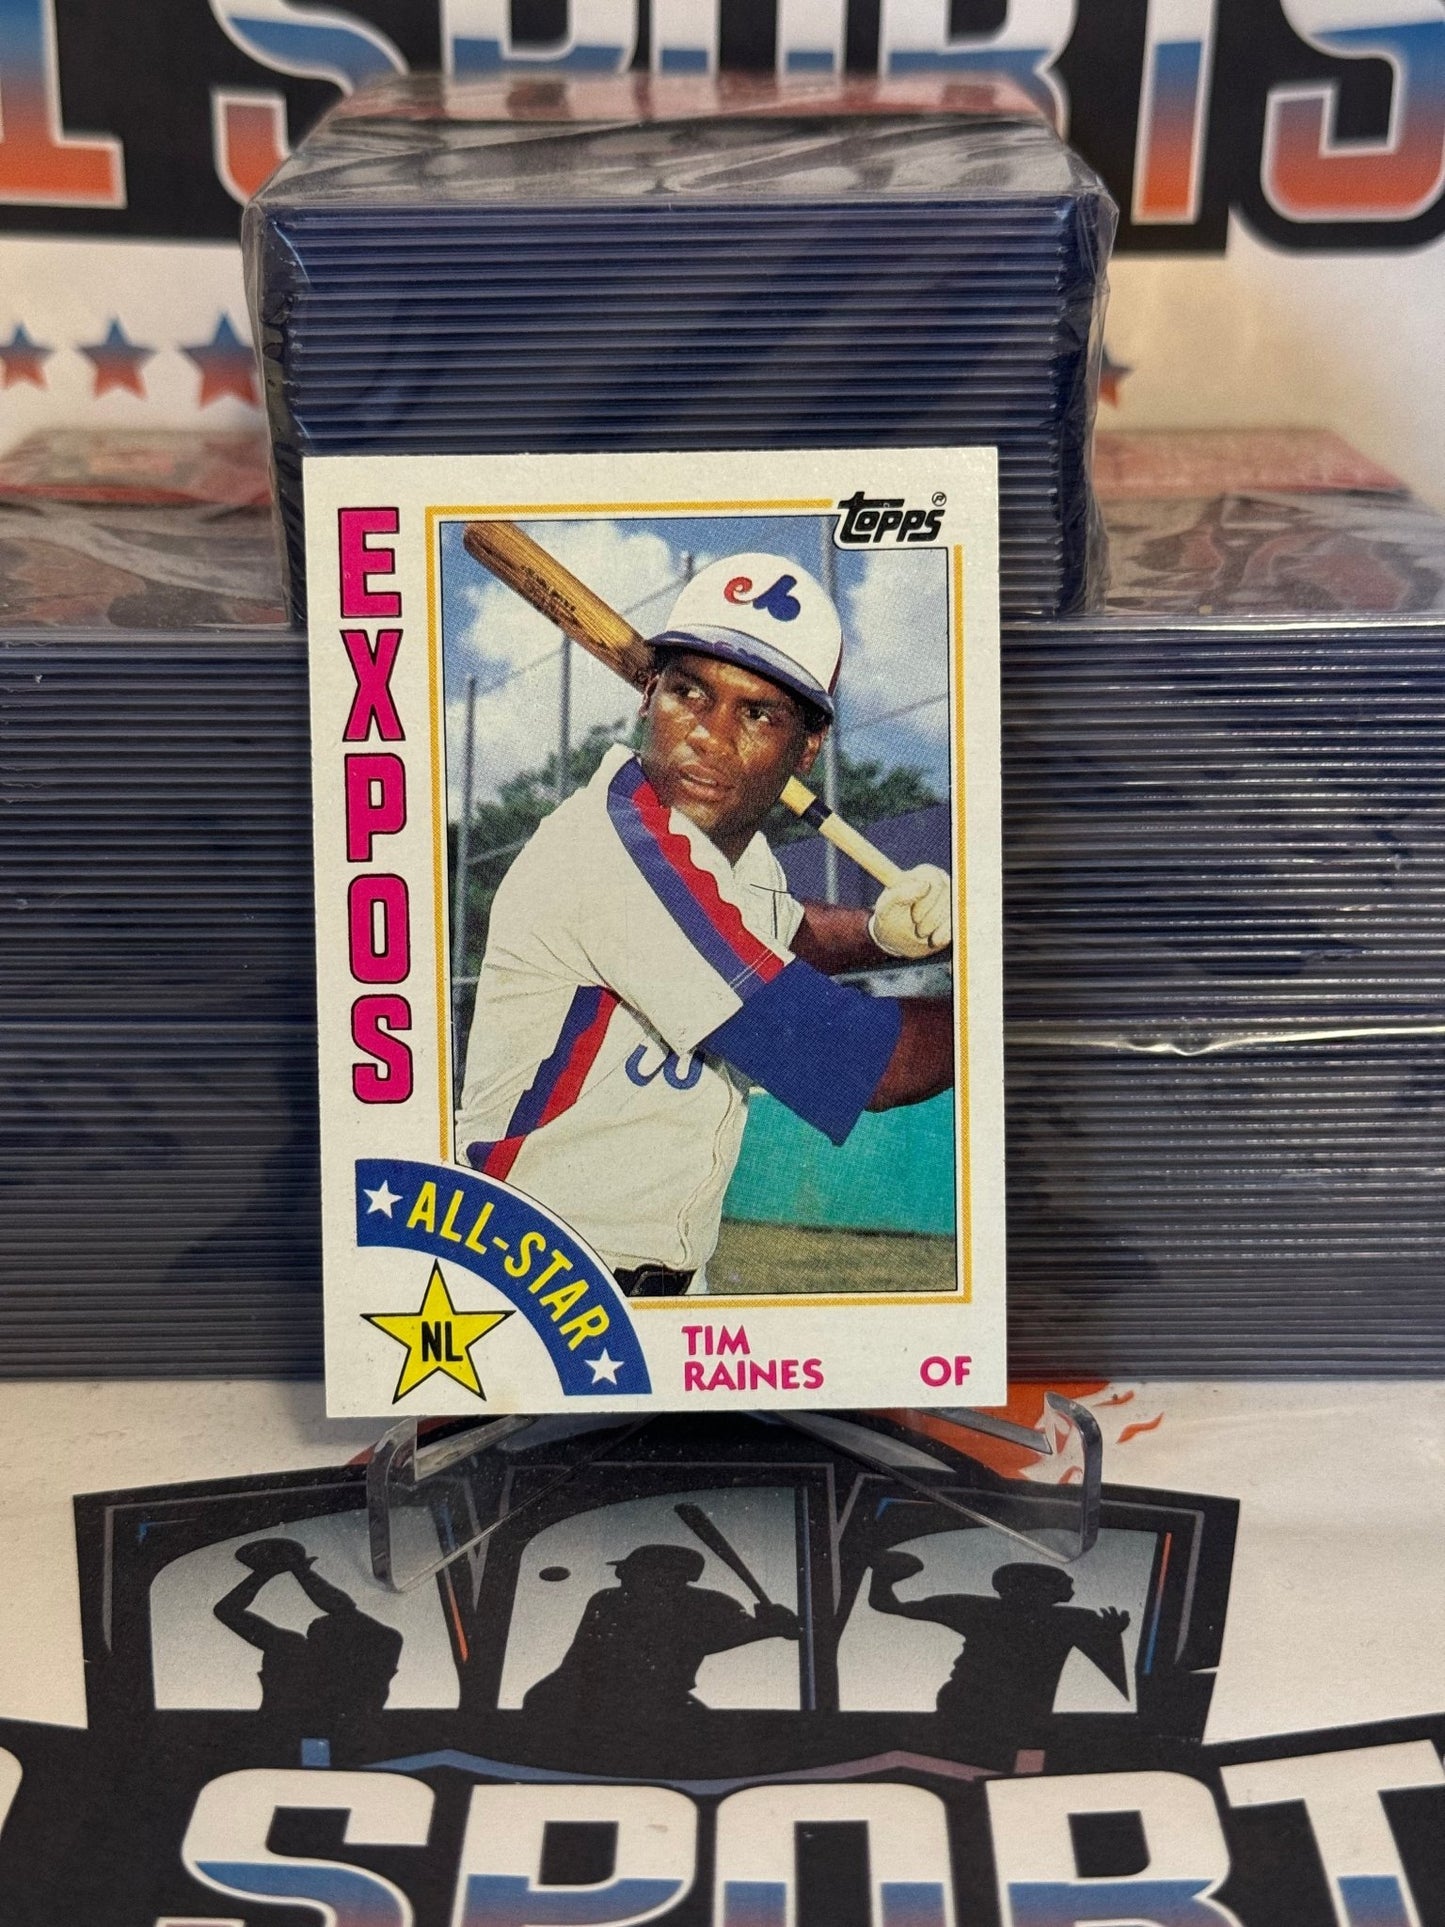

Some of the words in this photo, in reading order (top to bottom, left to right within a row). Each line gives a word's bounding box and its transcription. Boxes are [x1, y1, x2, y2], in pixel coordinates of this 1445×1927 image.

[338, 507, 414, 1105] EXPOS
[406, 1181, 609, 1352] ALL-STAR
[421, 1321, 464, 1362] NL
[682, 1325, 751, 1356] TIM
[684, 1358, 825, 1391] RAINES
[920, 1356, 973, 1387] OF
